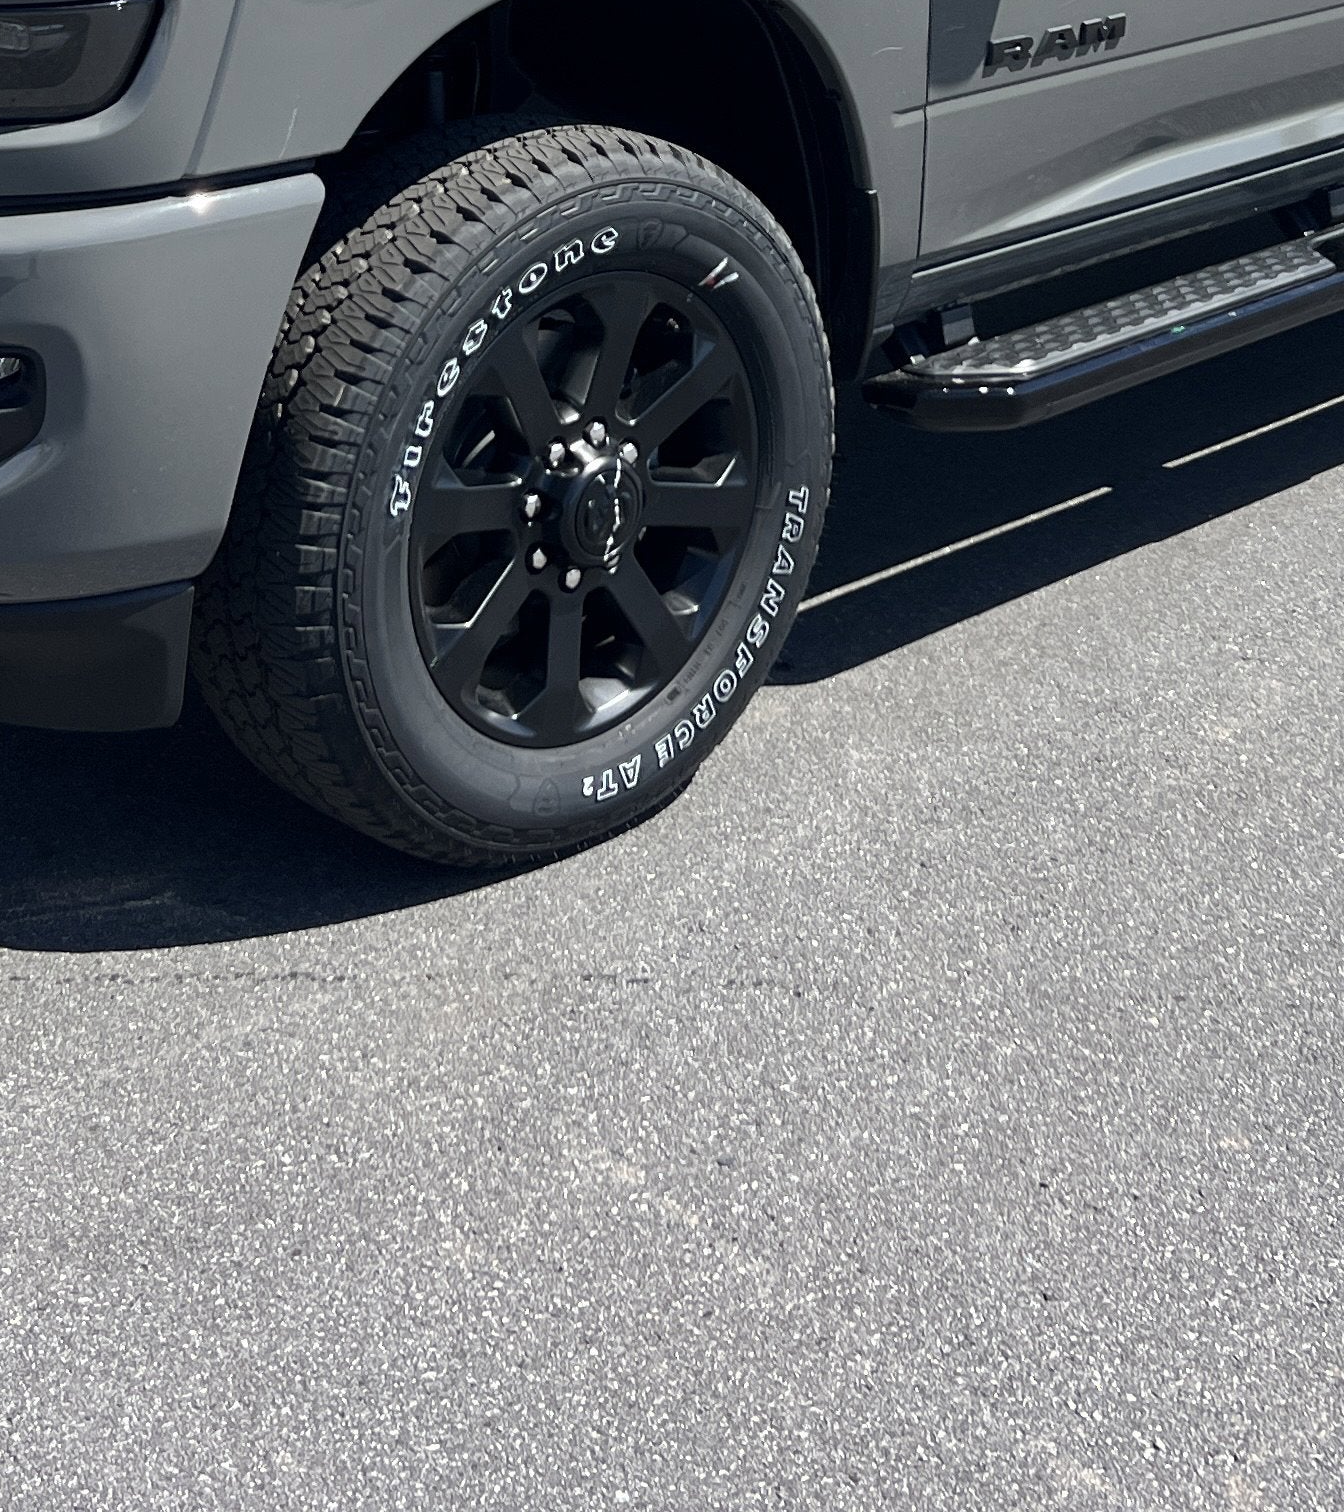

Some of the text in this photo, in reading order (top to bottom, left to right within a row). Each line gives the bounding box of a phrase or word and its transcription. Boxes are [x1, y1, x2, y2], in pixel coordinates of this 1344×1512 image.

[986, 12, 1127, 68] RAM
[389, 226, 619, 517] Firestone
[655, 486, 809, 768] TRANSFORCE
